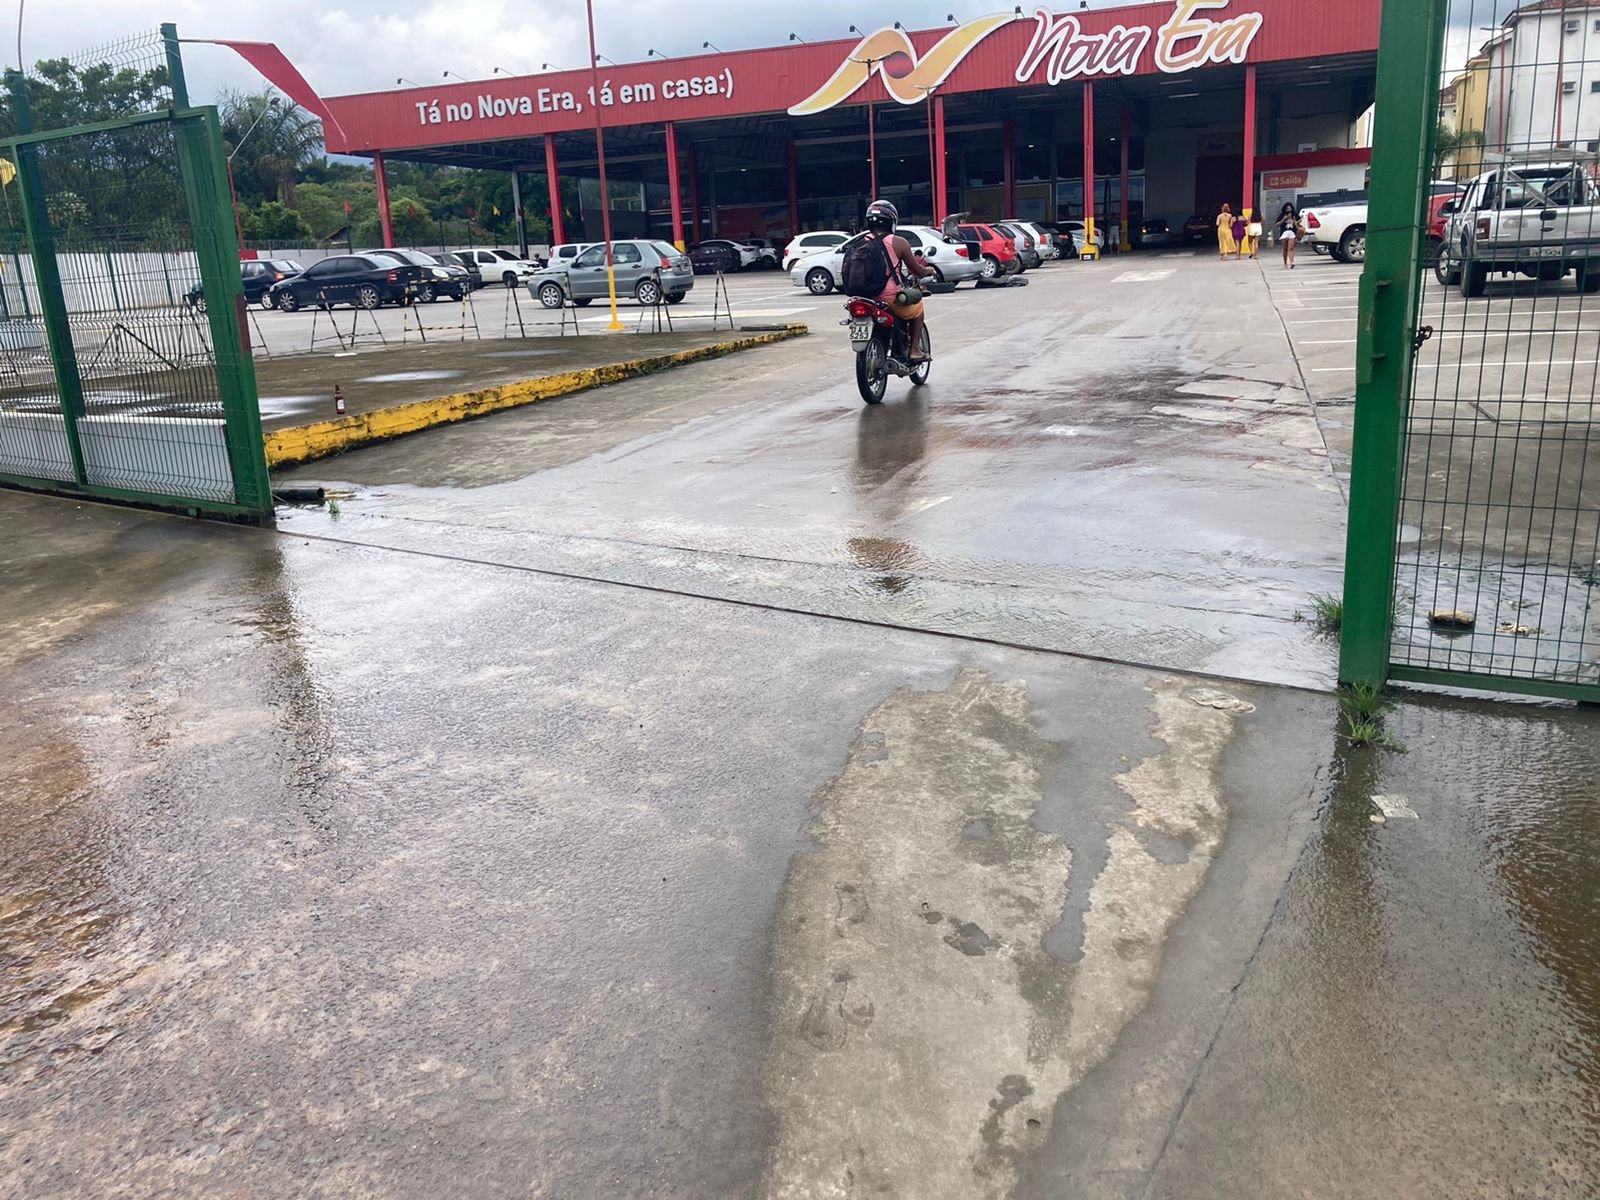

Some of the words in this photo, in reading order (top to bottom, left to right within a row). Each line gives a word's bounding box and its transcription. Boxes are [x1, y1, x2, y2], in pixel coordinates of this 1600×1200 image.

[1015, 7, 1151, 85] Nova
[1155, 0, 1263, 73] Era
[415, 99, 442, 125] Tá
[446, 102, 474, 123] no
[478, 94, 532, 119] Nova
[537, 87, 583, 114] Era,
[620, 82, 656, 104] em
